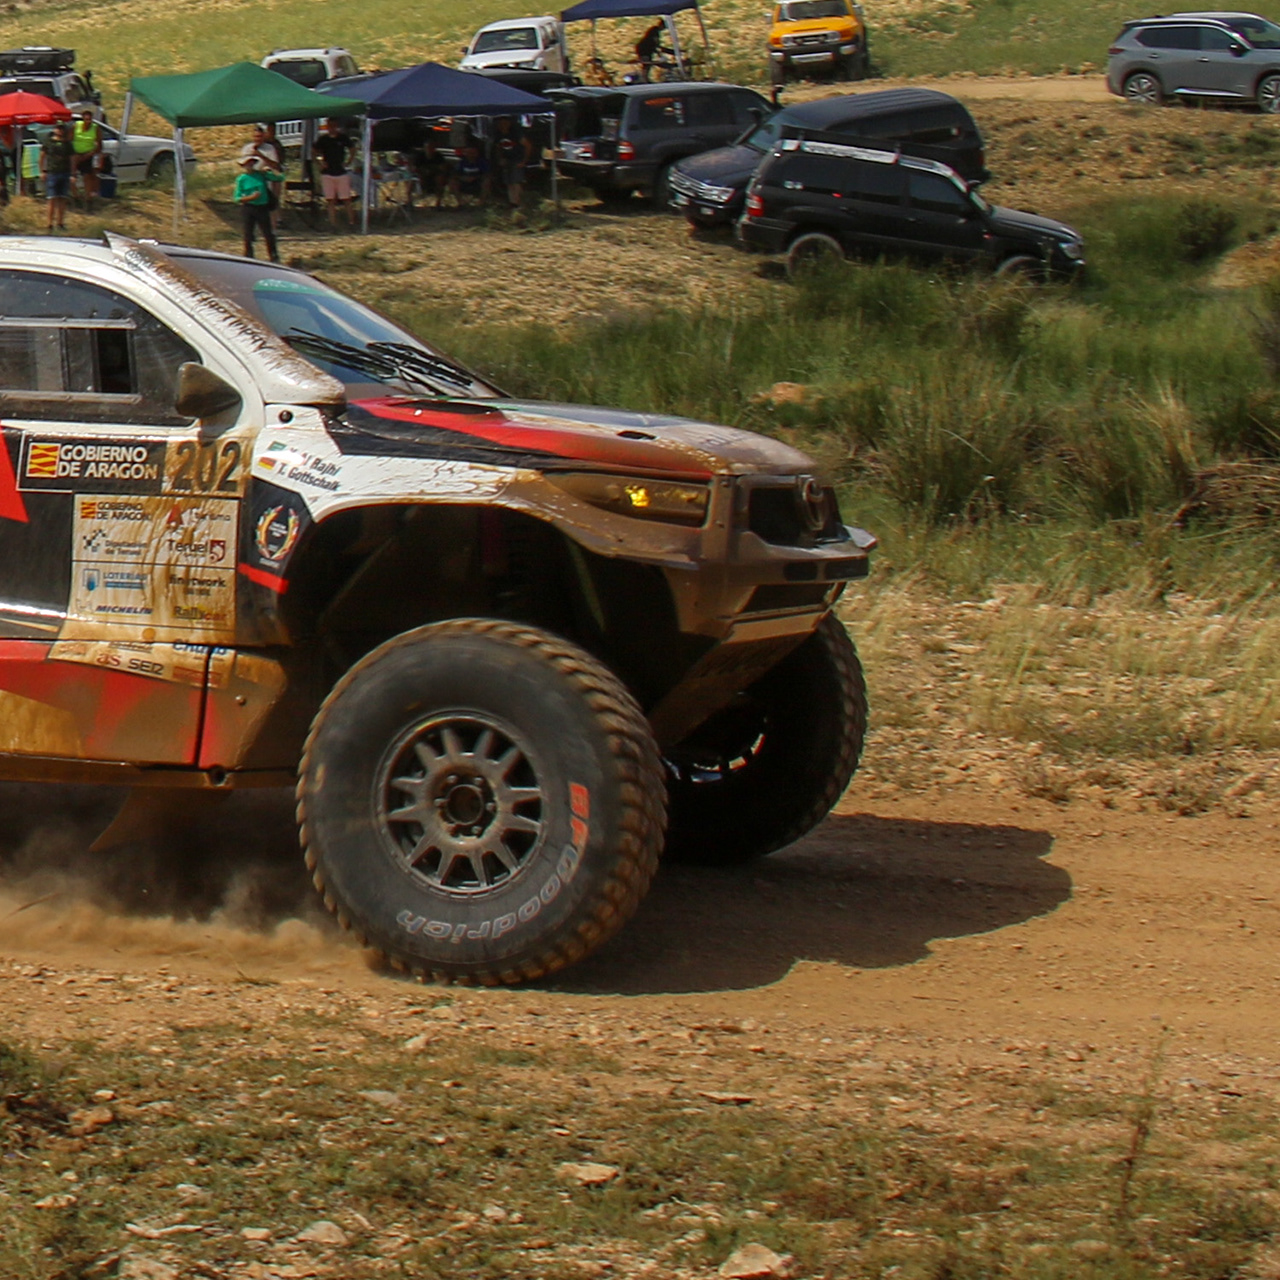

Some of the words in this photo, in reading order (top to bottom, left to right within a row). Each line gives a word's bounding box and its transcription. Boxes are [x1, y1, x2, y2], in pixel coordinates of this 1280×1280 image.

[60, 445, 147, 462] GOBIERNO
[58, 462, 80, 477] DE
[172, 441, 240, 491] 202
[288, 466, 340, 491] Gottschalk
[95, 605, 153, 615] MICHELIN
[127, 658, 164, 676] SER
